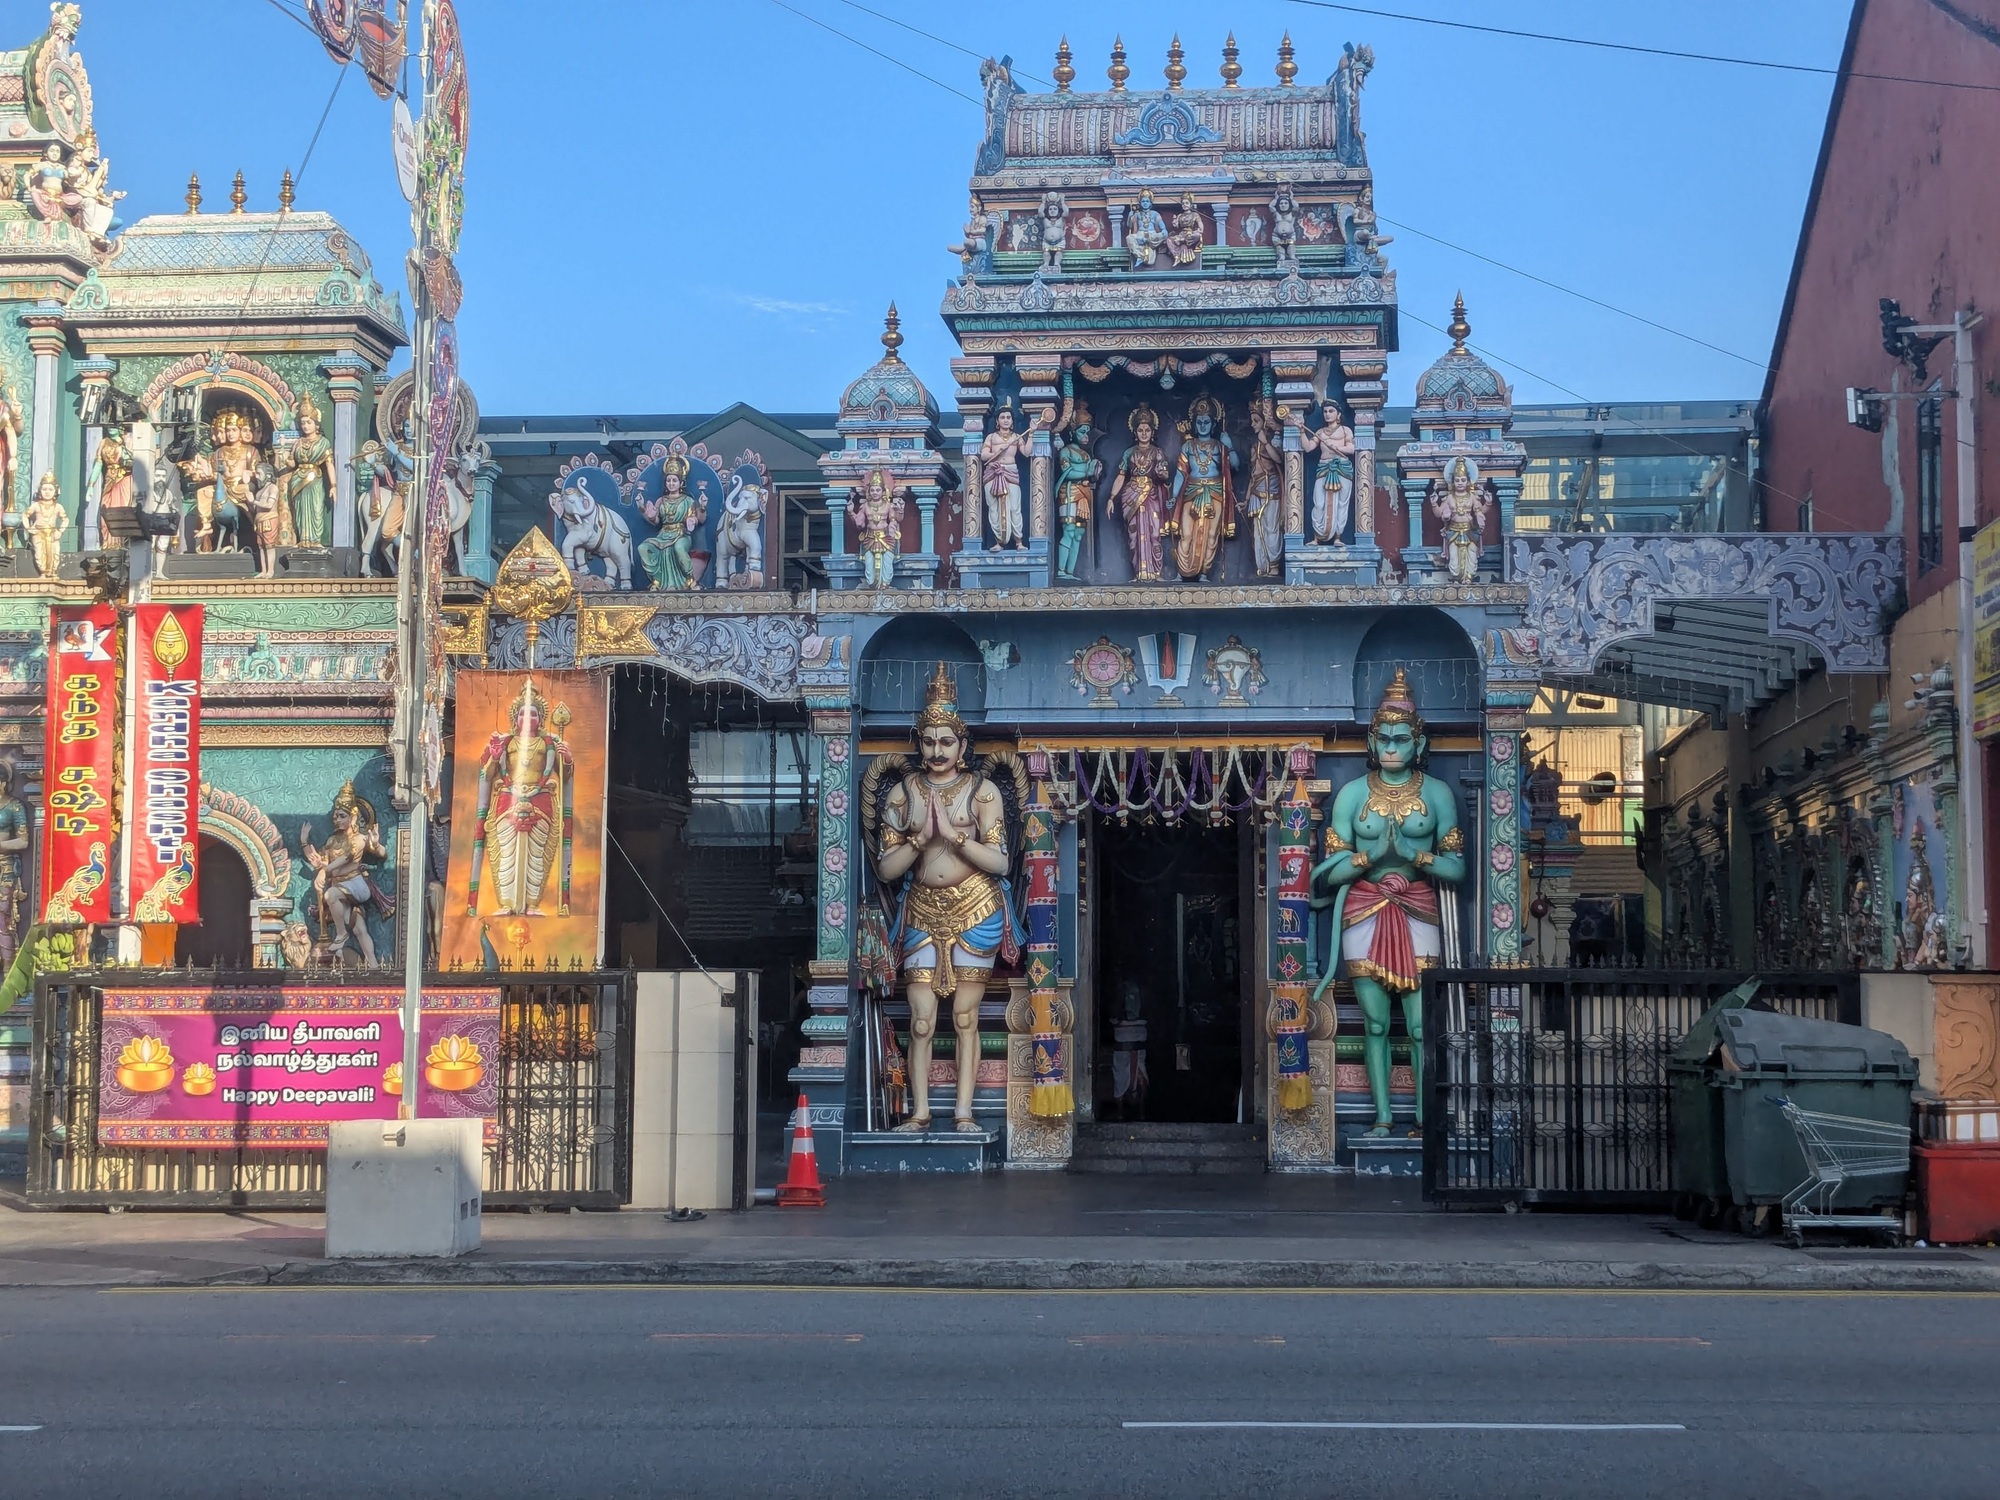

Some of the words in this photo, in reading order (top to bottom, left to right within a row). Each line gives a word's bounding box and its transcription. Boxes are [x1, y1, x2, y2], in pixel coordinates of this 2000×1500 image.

[60, 675, 101, 744] கந்த
[145, 680, 197, 763] Kandha
[50, 766, 107, 836] சஷ்டி
[145, 768, 191, 863] Shashti
[217, 1050, 378, 1073] நல்வாழ்த்துகள்!
[221, 1023, 288, 1045] இனிய
[292, 1021, 381, 1044] தீபாவளி
[223, 1088, 278, 1105] Happy
[283, 1086, 375, 1105] Deepavali!
